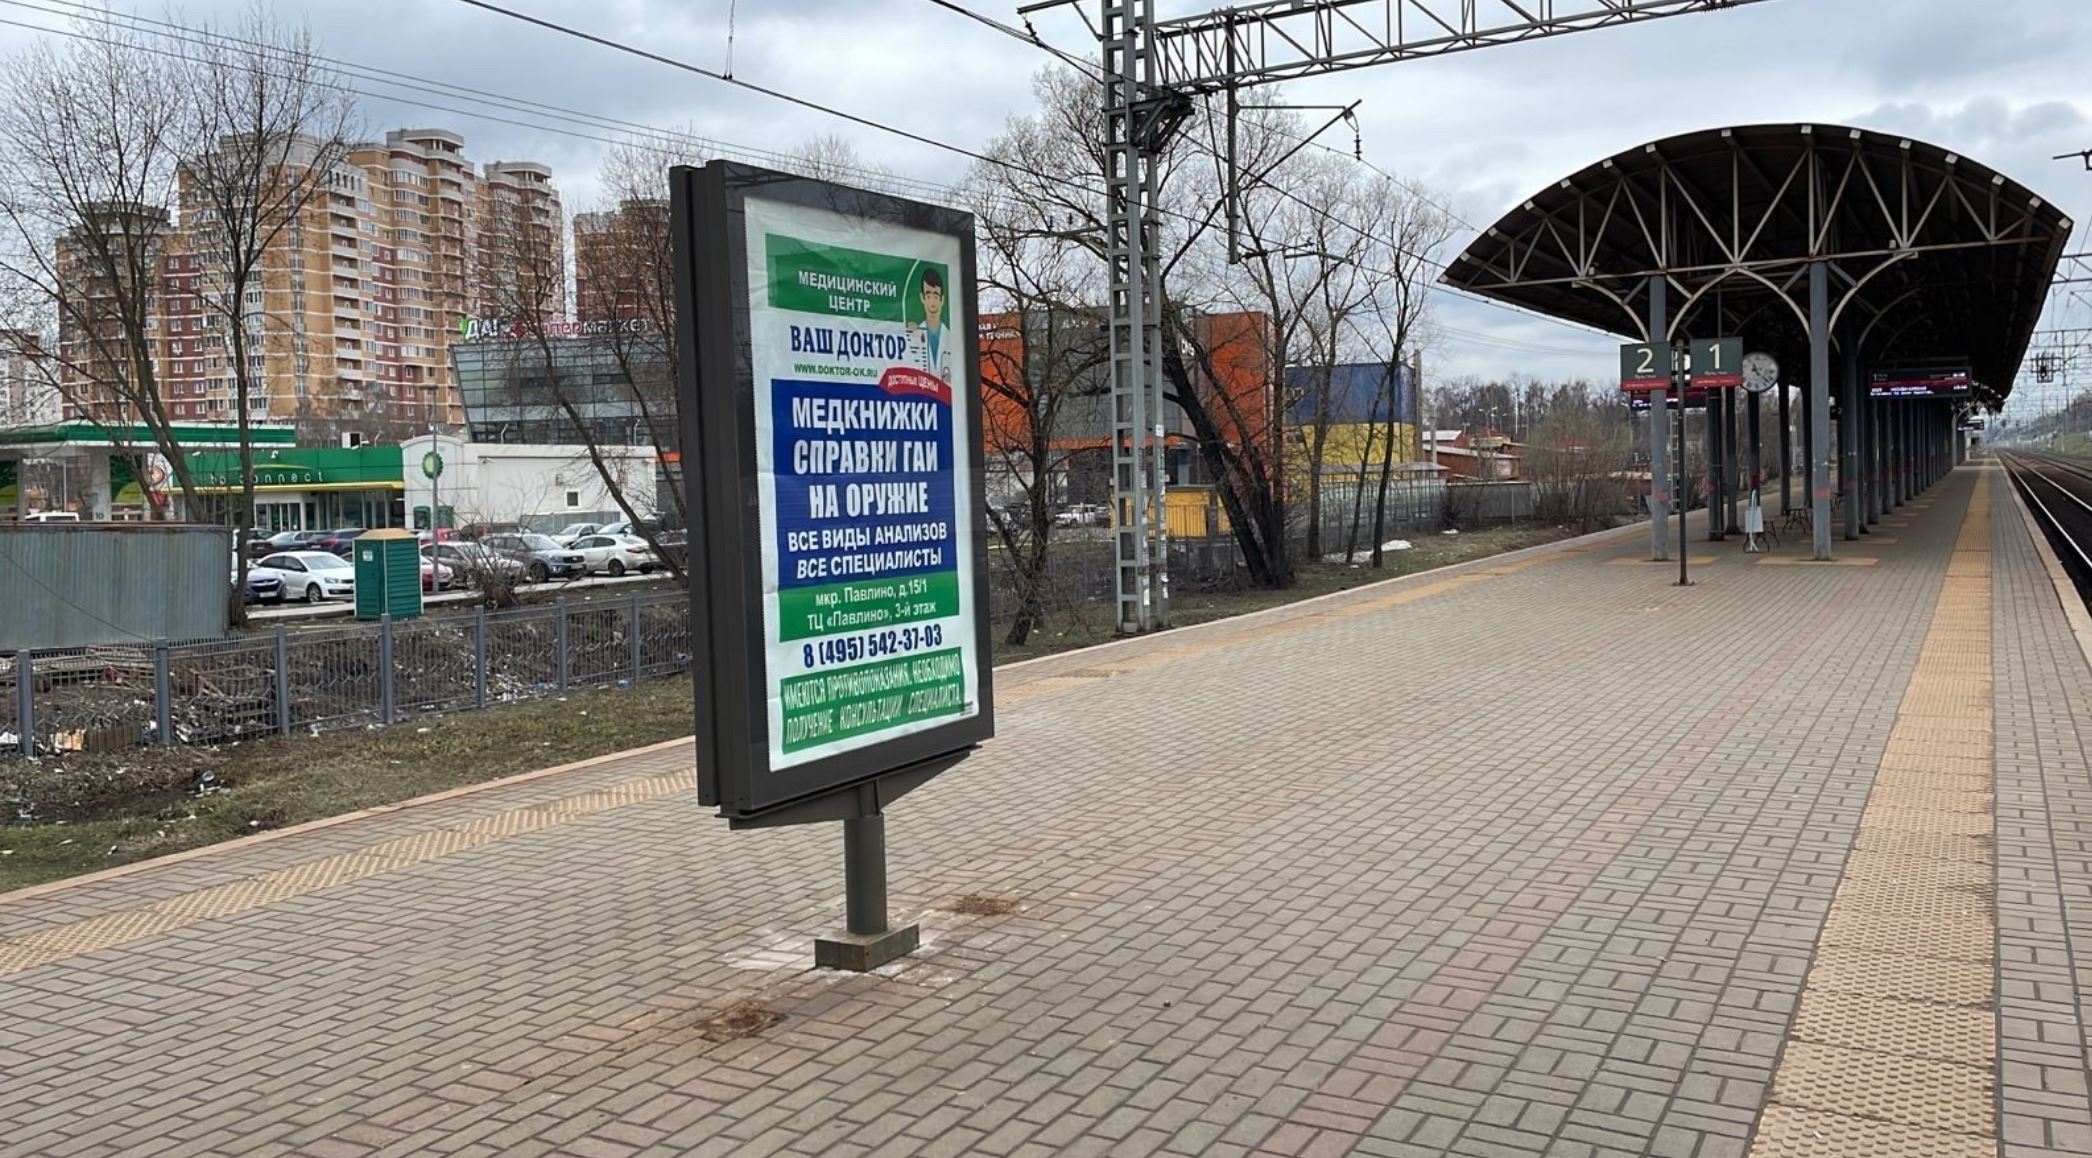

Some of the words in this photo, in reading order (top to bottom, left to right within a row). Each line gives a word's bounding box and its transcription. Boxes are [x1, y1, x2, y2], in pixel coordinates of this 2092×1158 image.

[798, 270, 897, 297] МЕДИЦИНСКИЙ
[829, 295, 871, 312] ЦЕНТР
[790, 325, 834, 355] ВАШ
[837, 330, 906, 361] ДОКТОР
[1708, 343, 1720, 369] 1
[794, 363, 878, 378] WWW.DOKTOR-OK.RU
[1636, 347, 1654, 374] 2
[917, 375, 939, 393] ЦЕНЫ
[792, 397, 938, 435] МЕДКНИЖКИ
[794, 440, 897, 475] СПРАВКИ
[903, 441, 938, 472] ГАИ
[809, 484, 839, 519] НА
[846, 482, 929, 517] ОРУЖИЕ
[788, 531, 819, 552] ВСЕ
[822, 527, 870, 551] ВИДЫ
[875, 522, 947, 545] АНАЛИЗОВ
[797, 558, 827, 579] ВСЕ
[831, 548, 942, 575] СПЕЦИАЛИСТЫ
[815, 593, 842, 609] мкр.
[844, 586, 897, 603] Павлино,
[899, 578, 927, 598] д.15/1
[807, 613, 824, 632] ТЦ
[826, 610, 893, 628] «Павлино»,
[895, 602, 911, 618] 3-й
[913, 601, 937, 615] этаж
[803, 643, 815, 669] 8
[819, 636, 864, 665] (495)
[868, 623, 943, 658] 542-37-03
[783, 677, 826, 711] ИМЕЮТСЯ
[827, 662, 912, 699] ПРОТИВОПОКАЗАНИЯ.
[913, 653, 960, 683] НЕОБХОДИМО
[785, 709, 834, 744] ПОЛУЧЕНИЕ
[839, 694, 904, 730] КОНСУЛЬТАЦИИ
